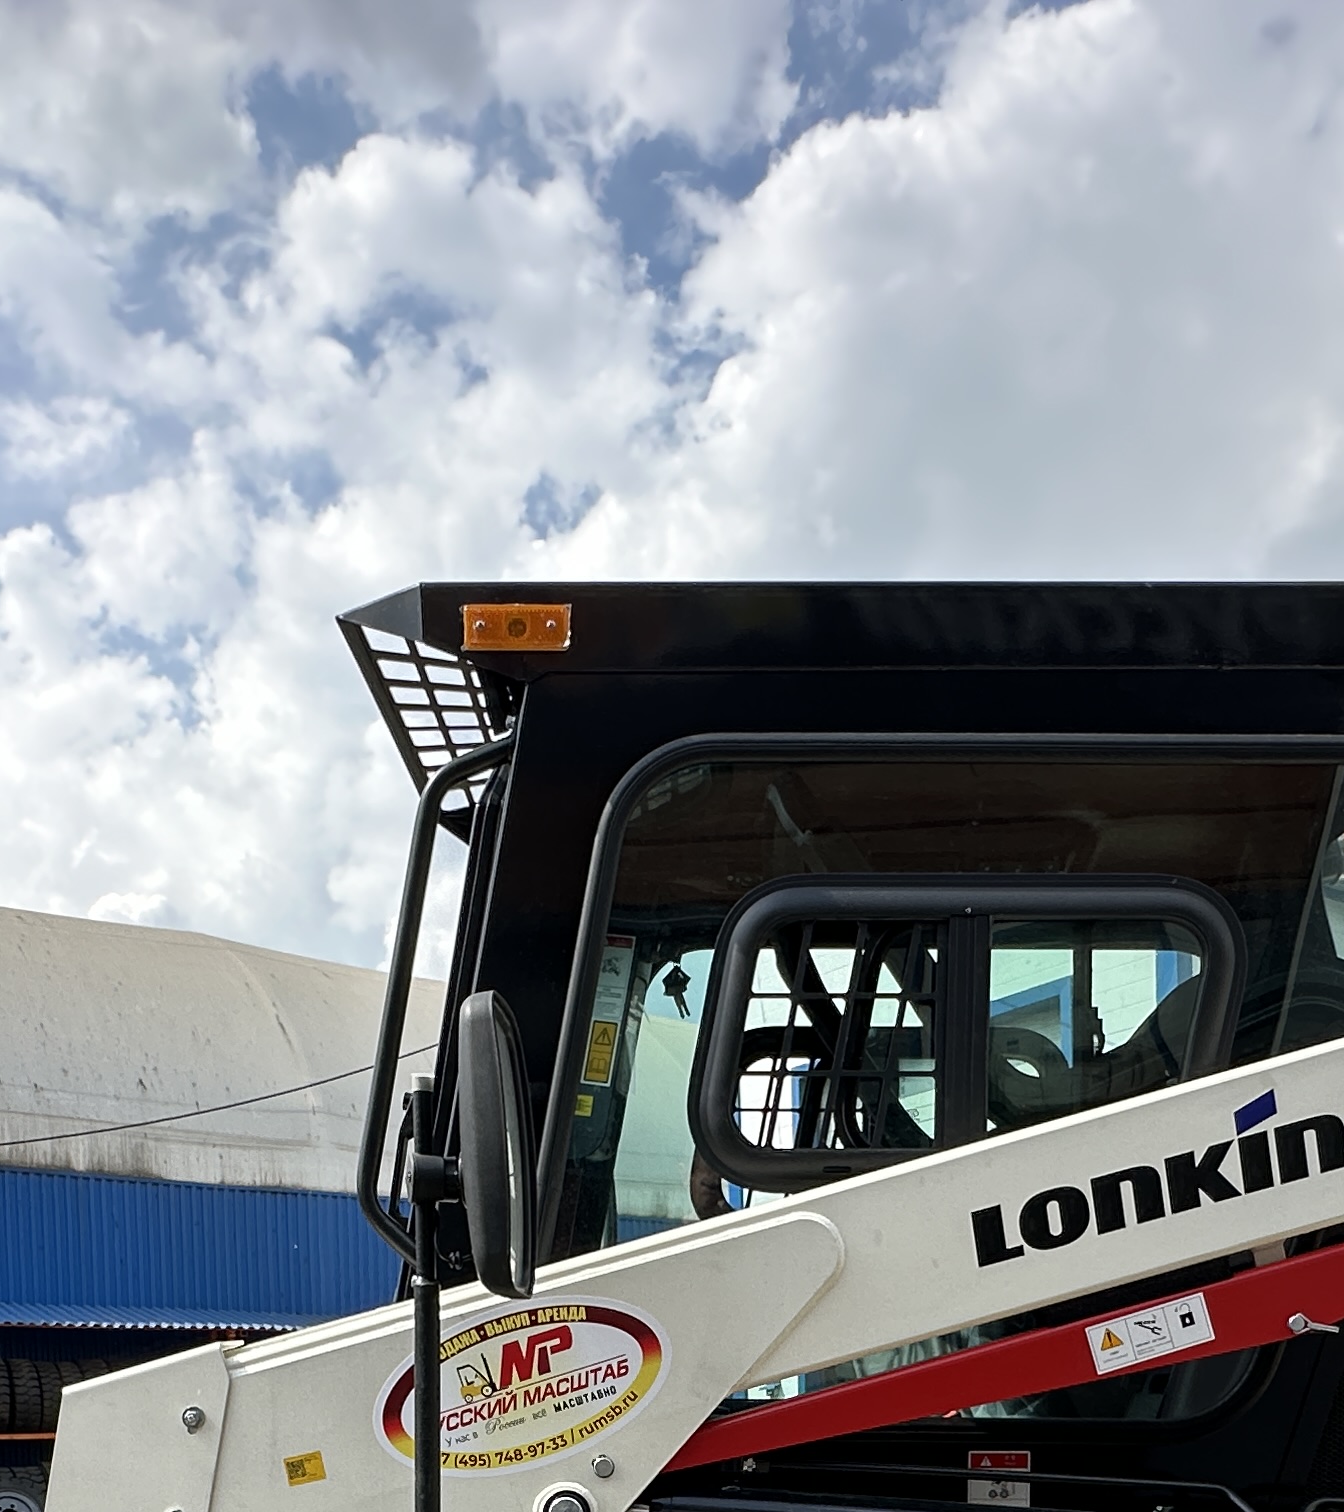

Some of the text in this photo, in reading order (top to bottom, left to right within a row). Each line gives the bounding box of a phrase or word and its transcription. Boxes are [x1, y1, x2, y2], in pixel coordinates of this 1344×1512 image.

[485, 1312, 531, 1337] ВЫКУП
[537, 1306, 587, 1323] АРЕНДА
[523, 1358, 629, 1408] МАСШТАБ
[553, 1385, 617, 1413] МАСШТАБНО
[454, 1453, 492, 1469] (495)
[495, 1434, 568, 1465] 748-97-33
[578, 1391, 639, 1439] rumsb.ru
